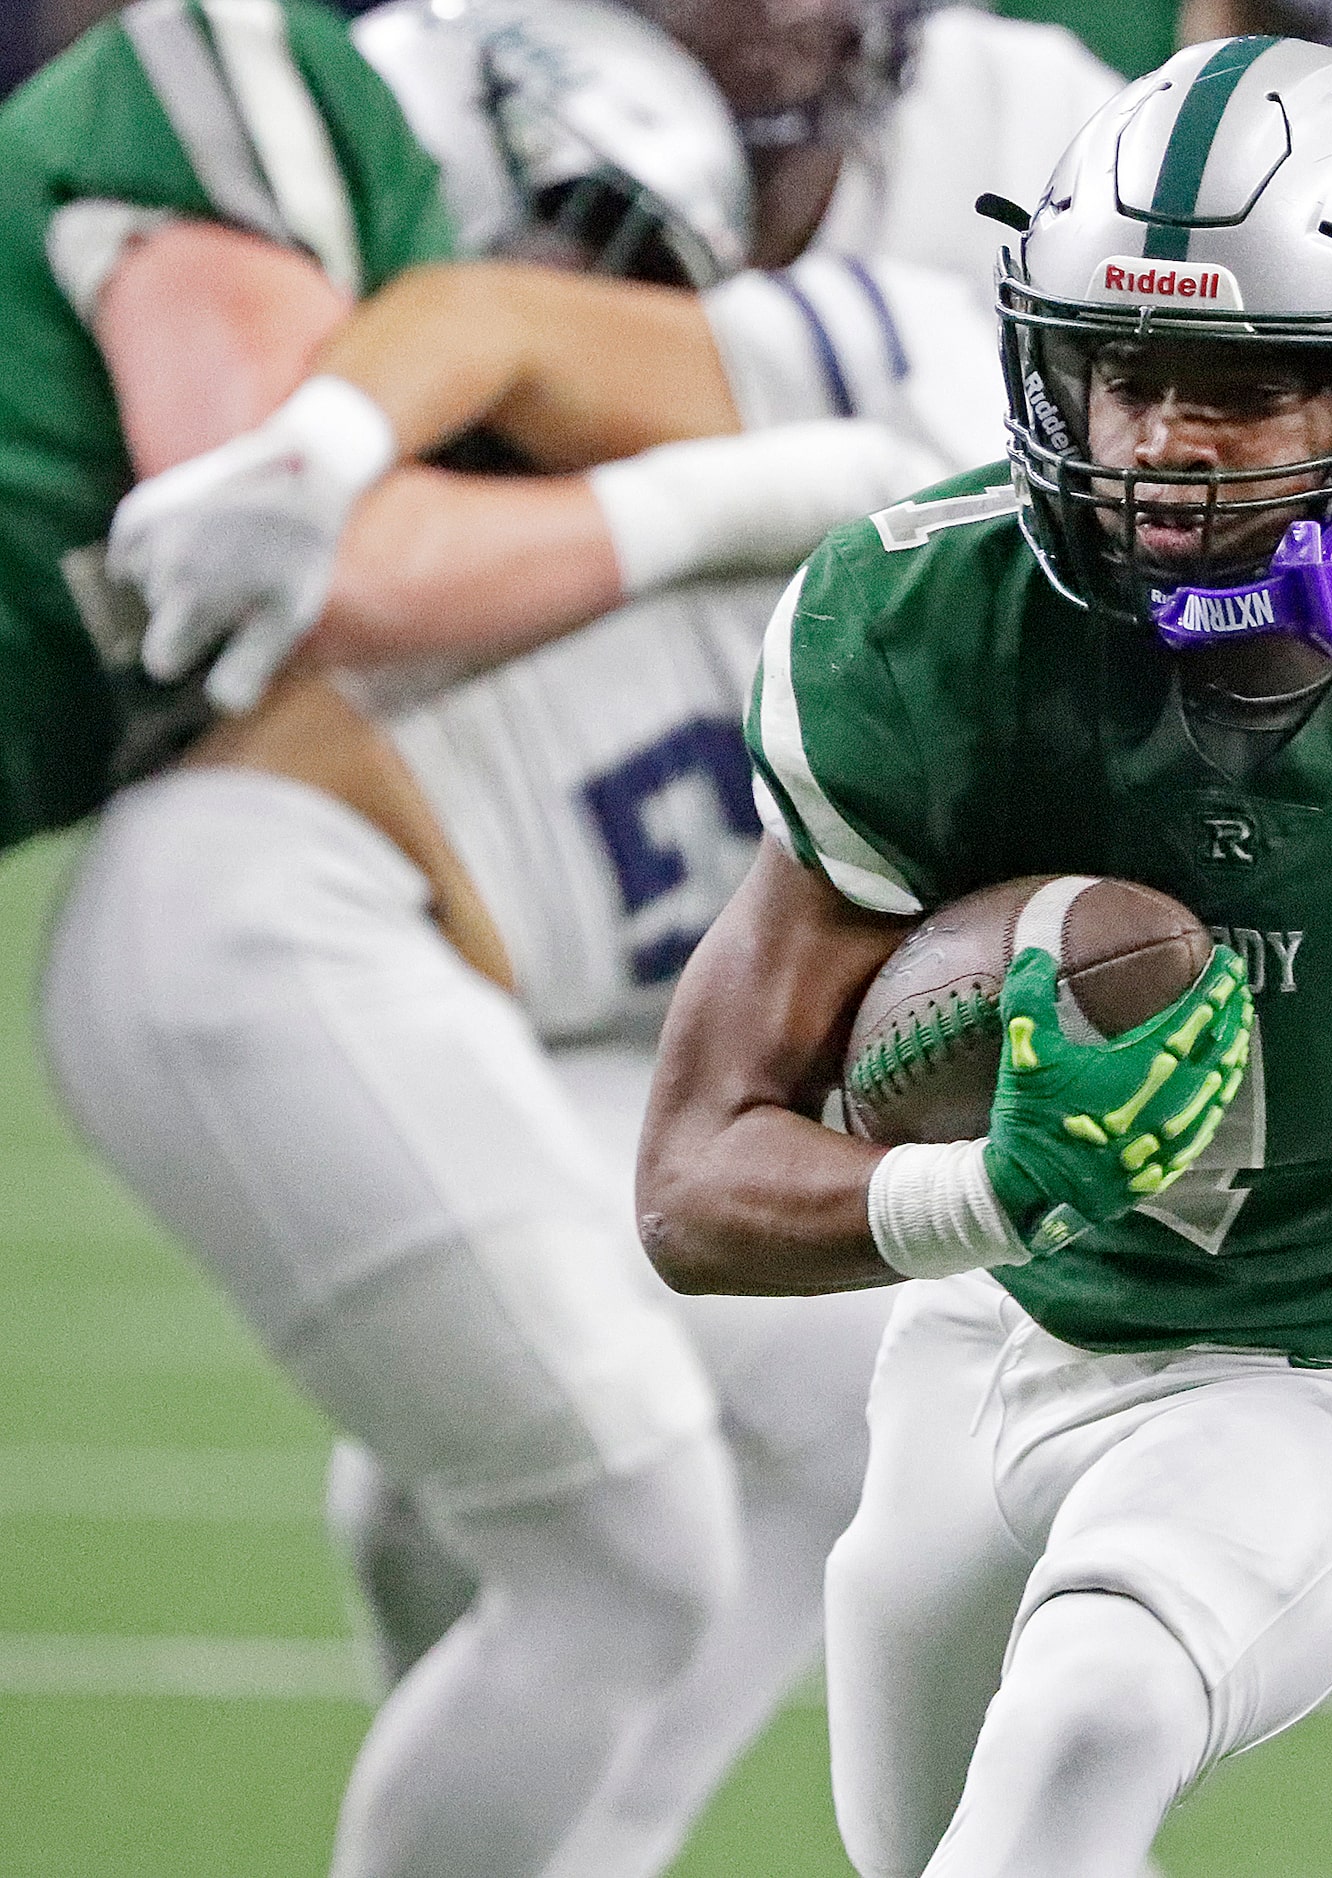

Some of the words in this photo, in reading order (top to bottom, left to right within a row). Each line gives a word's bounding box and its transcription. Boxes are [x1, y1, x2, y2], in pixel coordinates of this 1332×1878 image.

[1104, 263, 1220, 299] Riddell
[1182, 588, 1275, 633] NXTRND
[1202, 817, 1255, 864] R
[1211, 925, 1304, 994] DY
